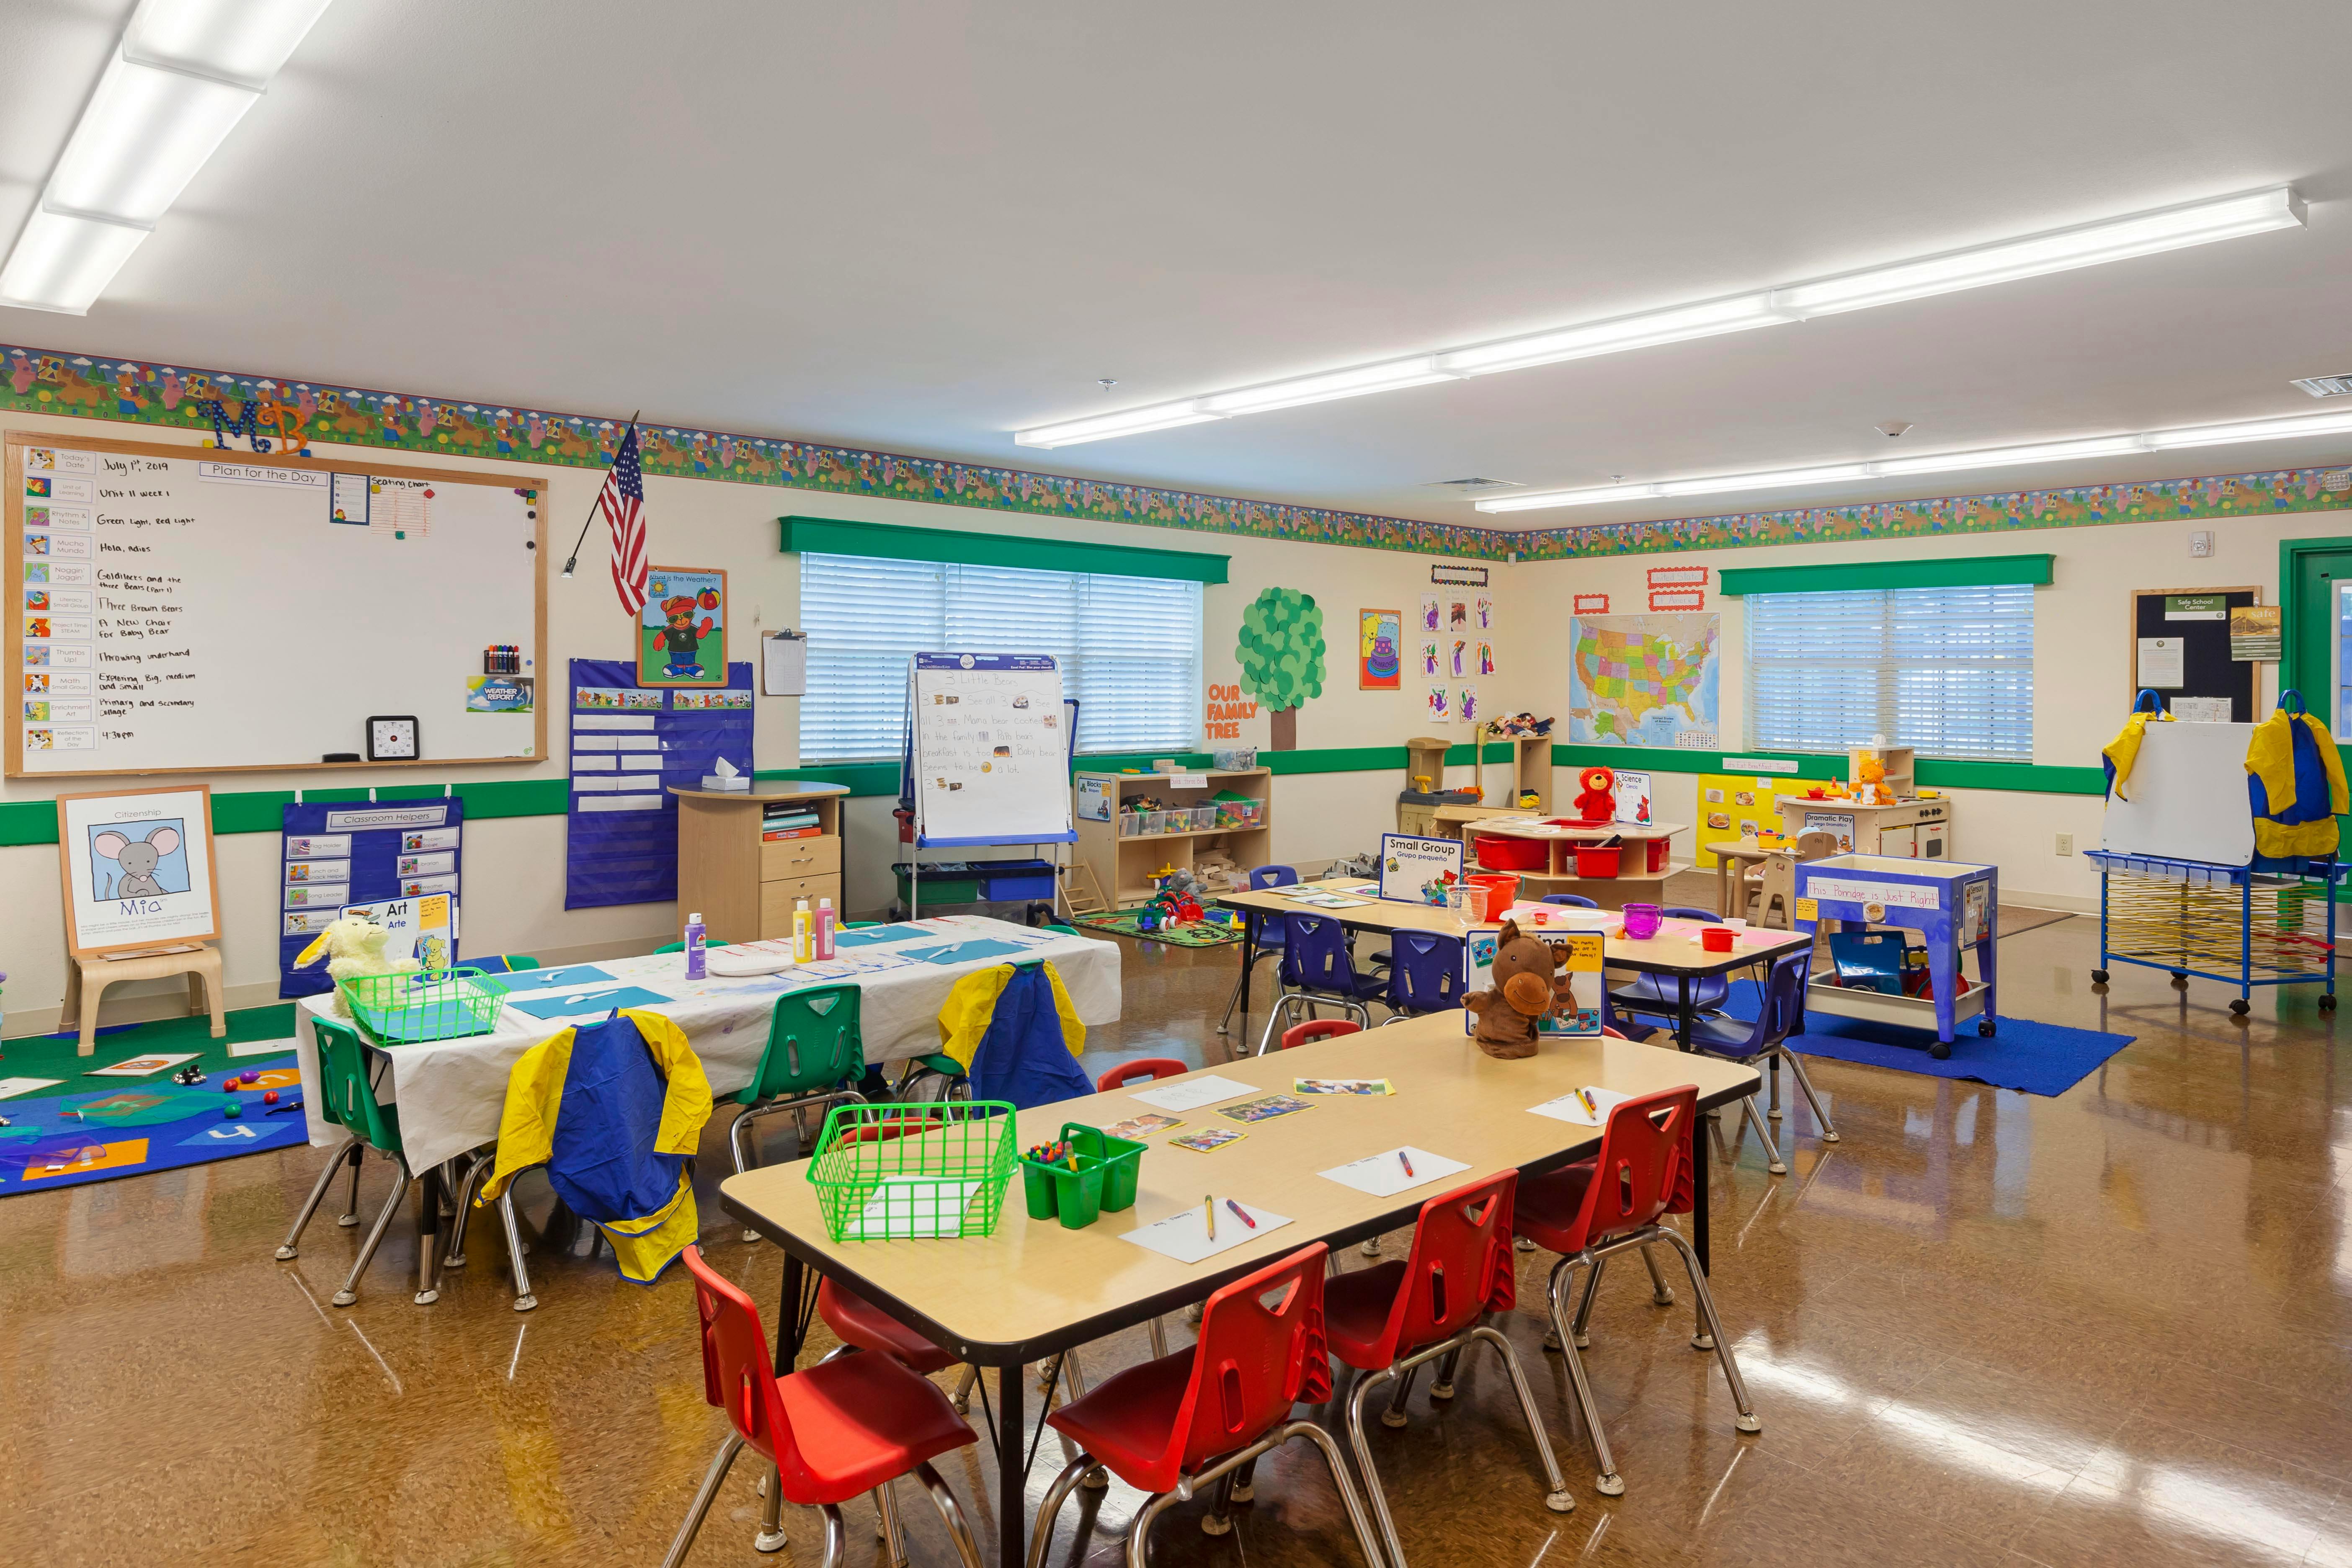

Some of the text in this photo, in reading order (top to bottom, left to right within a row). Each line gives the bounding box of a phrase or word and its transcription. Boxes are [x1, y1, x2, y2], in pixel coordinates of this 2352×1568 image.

[60, 454, 90, 462] Today's
[102, 459, 127, 476] July
[146, 462, 168, 472] 2019
[212, 464, 317, 485] Plan for the Day
[371, 476, 406, 490] Seating
[100, 489, 124, 498] Unit
[52, 511, 79, 519] Rhythm
[97, 514, 124, 525] Green
[101, 543, 125, 552] Hola,
[55, 567, 85, 575] Noggin'
[97, 569, 143, 581] Goldilocks
[56, 573, 84, 582] Joggin'
[1653, 572, 1702, 582] United States
[124, 582, 144, 591] Bears
[97, 597, 126, 611] Three
[1668, 595, 1698, 605] America
[2251, 609, 2275, 618] safe
[120, 630, 144, 639] Baby
[99, 649, 190, 663] Throwing underhand
[1372, 658, 1395, 668] PRIMROSE
[99, 673, 138, 685] Exploring
[145, 673, 162, 683] Big,
[945, 671, 1018, 686] 3 Little Bears
[484, 687, 518, 696] WEATHER
[1209, 684, 1240, 702] OUR
[487, 693, 515, 701] REPORT
[99, 699, 134, 709] Primary
[1207, 702, 1259, 721] FAMILY
[102, 731, 134, 740] 4:30pm
[1205, 722, 1240, 740] TREE
[1775, 763, 1798, 772] Together
[1621, 774, 1642, 784] Science
[114, 809, 161, 819] Citizenship
[344, 813, 430, 824] Classroom Helpers
[1807, 814, 1853, 824] Dramatic Play
[1390, 839, 1456, 856] Small Group
[1397, 851, 1447, 863] Grupo pequeño
[1808, 882, 1826, 895] This
[1884, 890, 1903, 901] Just
[1911, 891, 1938, 908] Right!
[120, 900, 162, 916] Mia
[387, 902, 407, 917] Art
[388, 920, 406, 929] Arte
